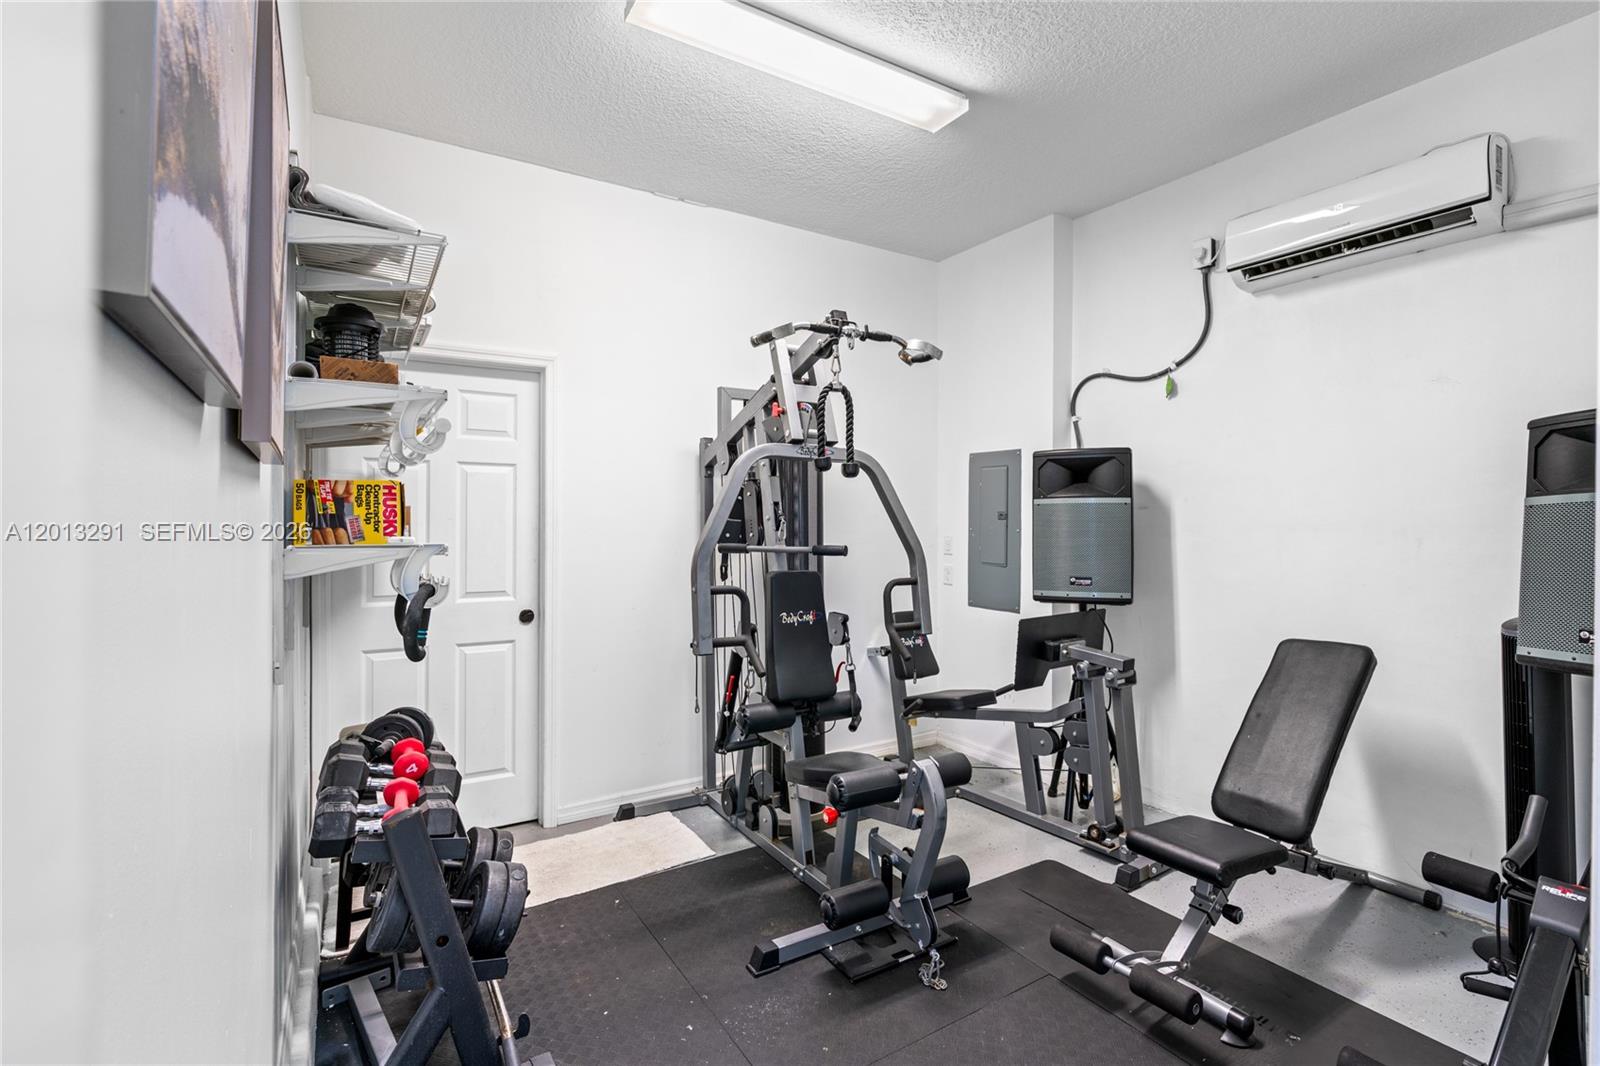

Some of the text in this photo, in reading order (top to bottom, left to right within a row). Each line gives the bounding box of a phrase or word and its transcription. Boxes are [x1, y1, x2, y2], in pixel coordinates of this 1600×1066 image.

[296, 483, 304, 494] 50
[356, 484, 364, 508] Bags
[364, 484, 373, 525] Clean-Up
[373, 484, 381, 533] Contractor
[382, 484, 398, 537] HUSKY
[405, 763, 418, 774] 4
